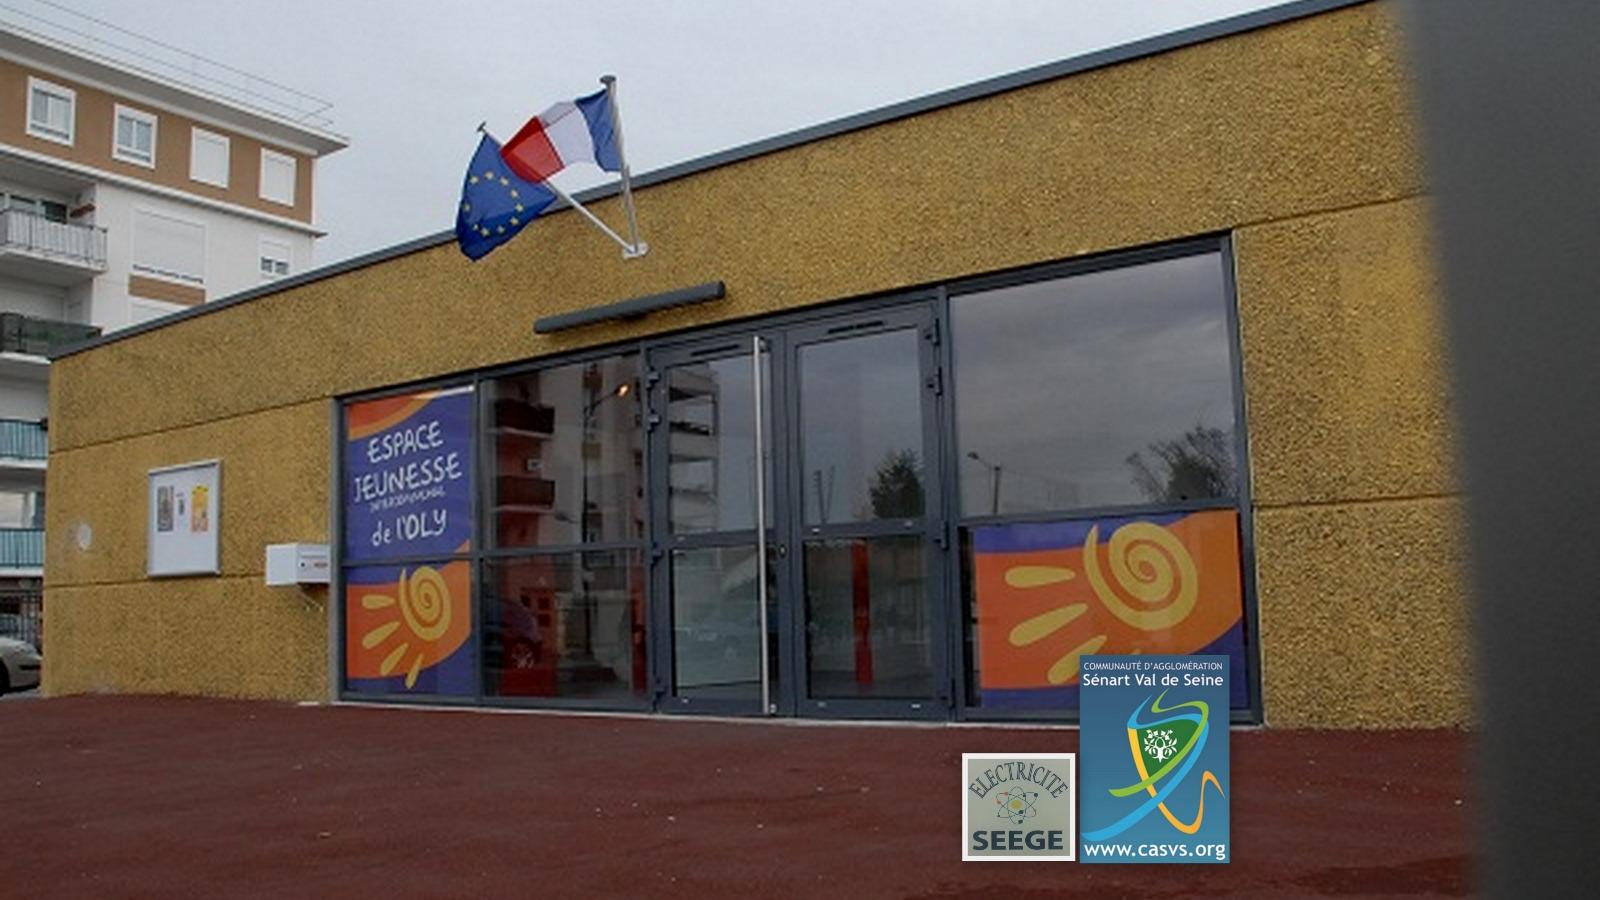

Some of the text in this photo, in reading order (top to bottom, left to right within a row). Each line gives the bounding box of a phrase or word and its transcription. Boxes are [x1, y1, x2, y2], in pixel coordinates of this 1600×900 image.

[367, 421, 443, 463] ESPACE
[354, 453, 462, 502] JEUNESSE
[372, 509, 447, 546] de l'OLY
